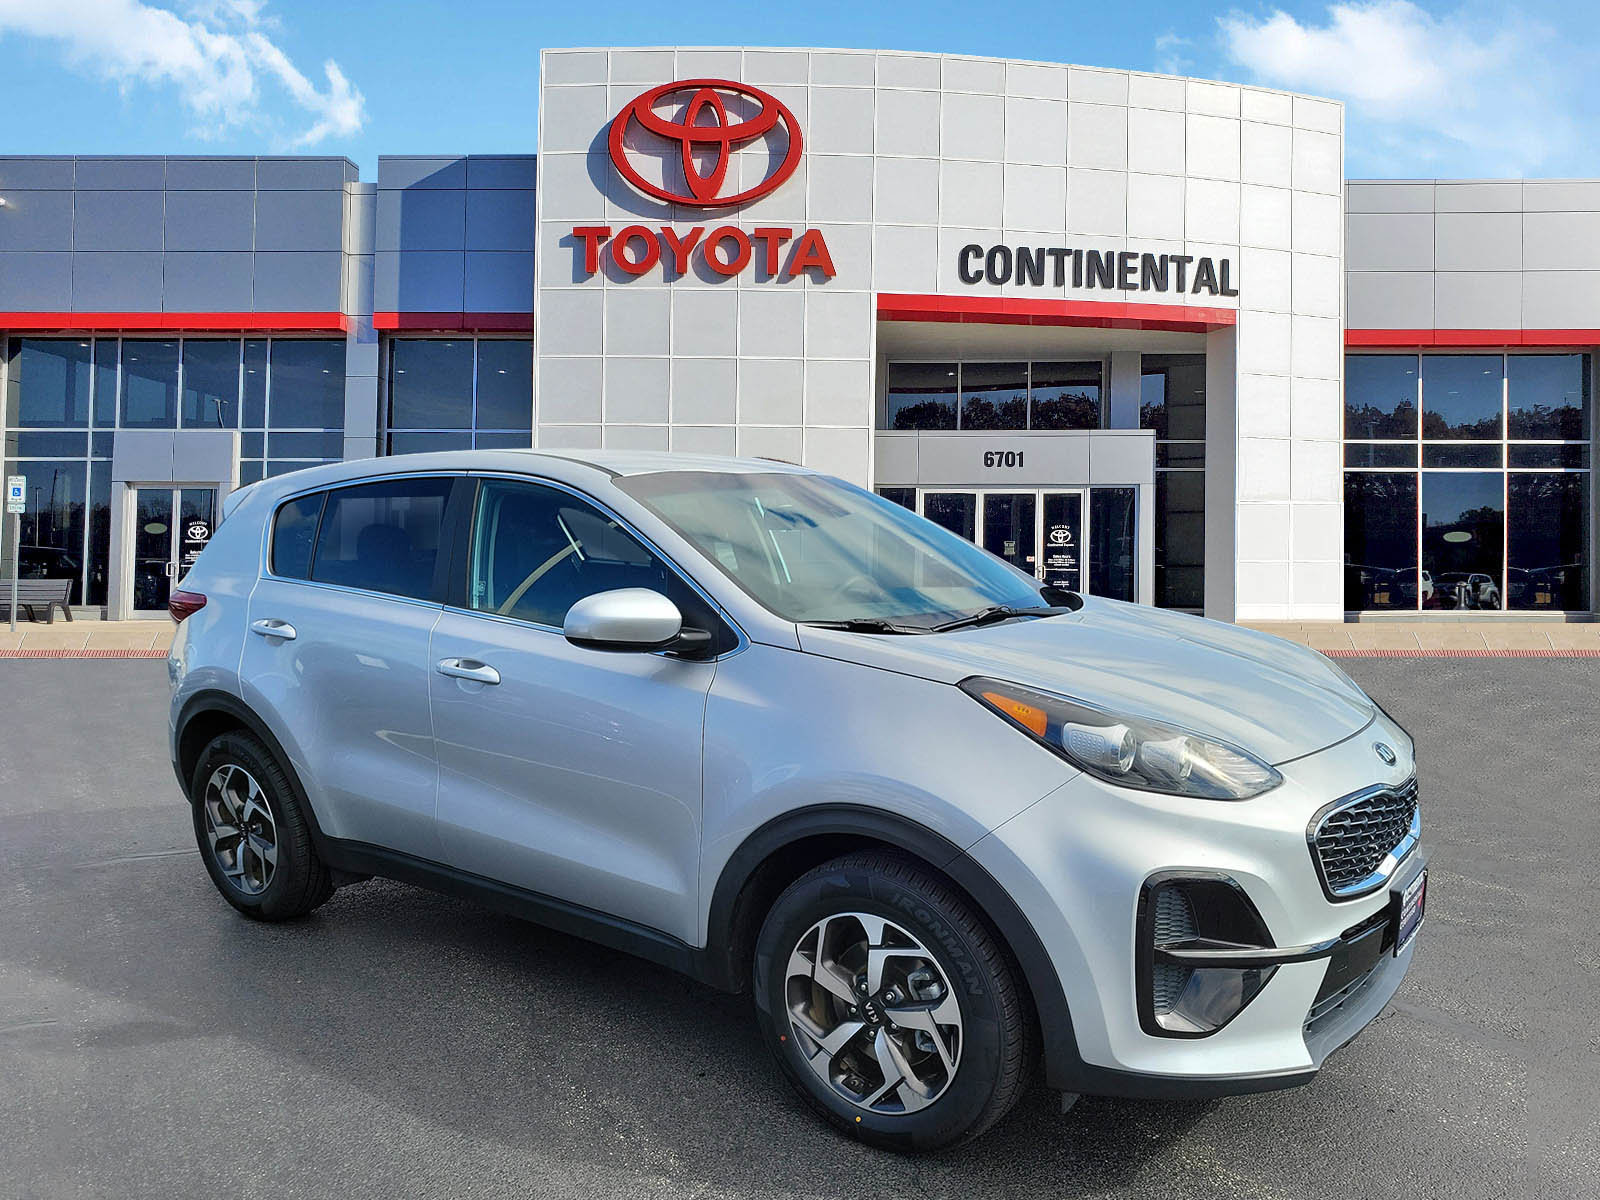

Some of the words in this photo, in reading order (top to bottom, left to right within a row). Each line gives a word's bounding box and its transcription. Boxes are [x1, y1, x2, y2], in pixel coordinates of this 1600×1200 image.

[572, 226, 837, 277] TOYOTA
[958, 244, 1239, 297] CONTINENTAL
[984, 451, 1024, 468] 6701
[865, 1001, 879, 1023] KIA
